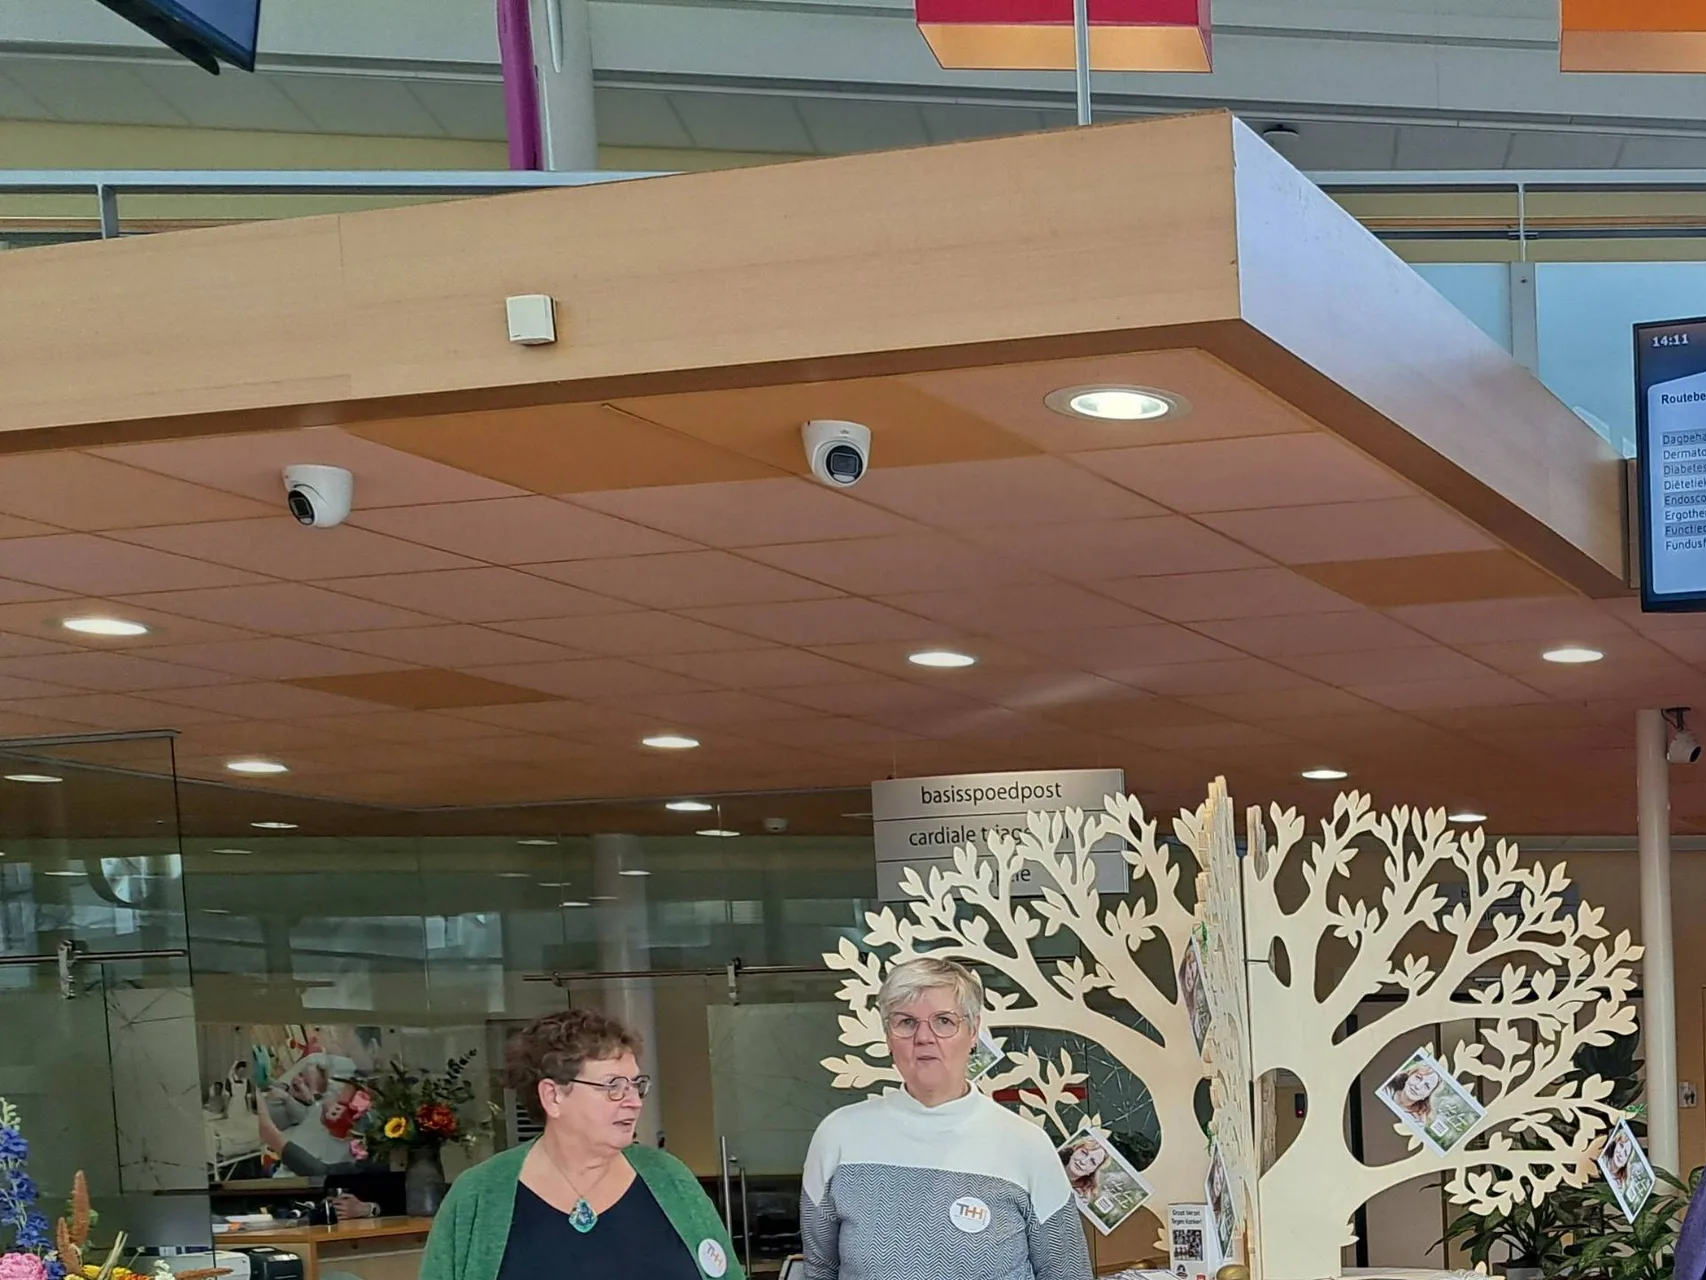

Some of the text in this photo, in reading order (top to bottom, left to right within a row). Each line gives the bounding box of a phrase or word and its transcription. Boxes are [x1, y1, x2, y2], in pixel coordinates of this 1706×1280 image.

[1651, 333, 1689, 347] 14:11
[921, 781, 1062, 806] basisspoedpost
[909, 825, 976, 846] cardiale
